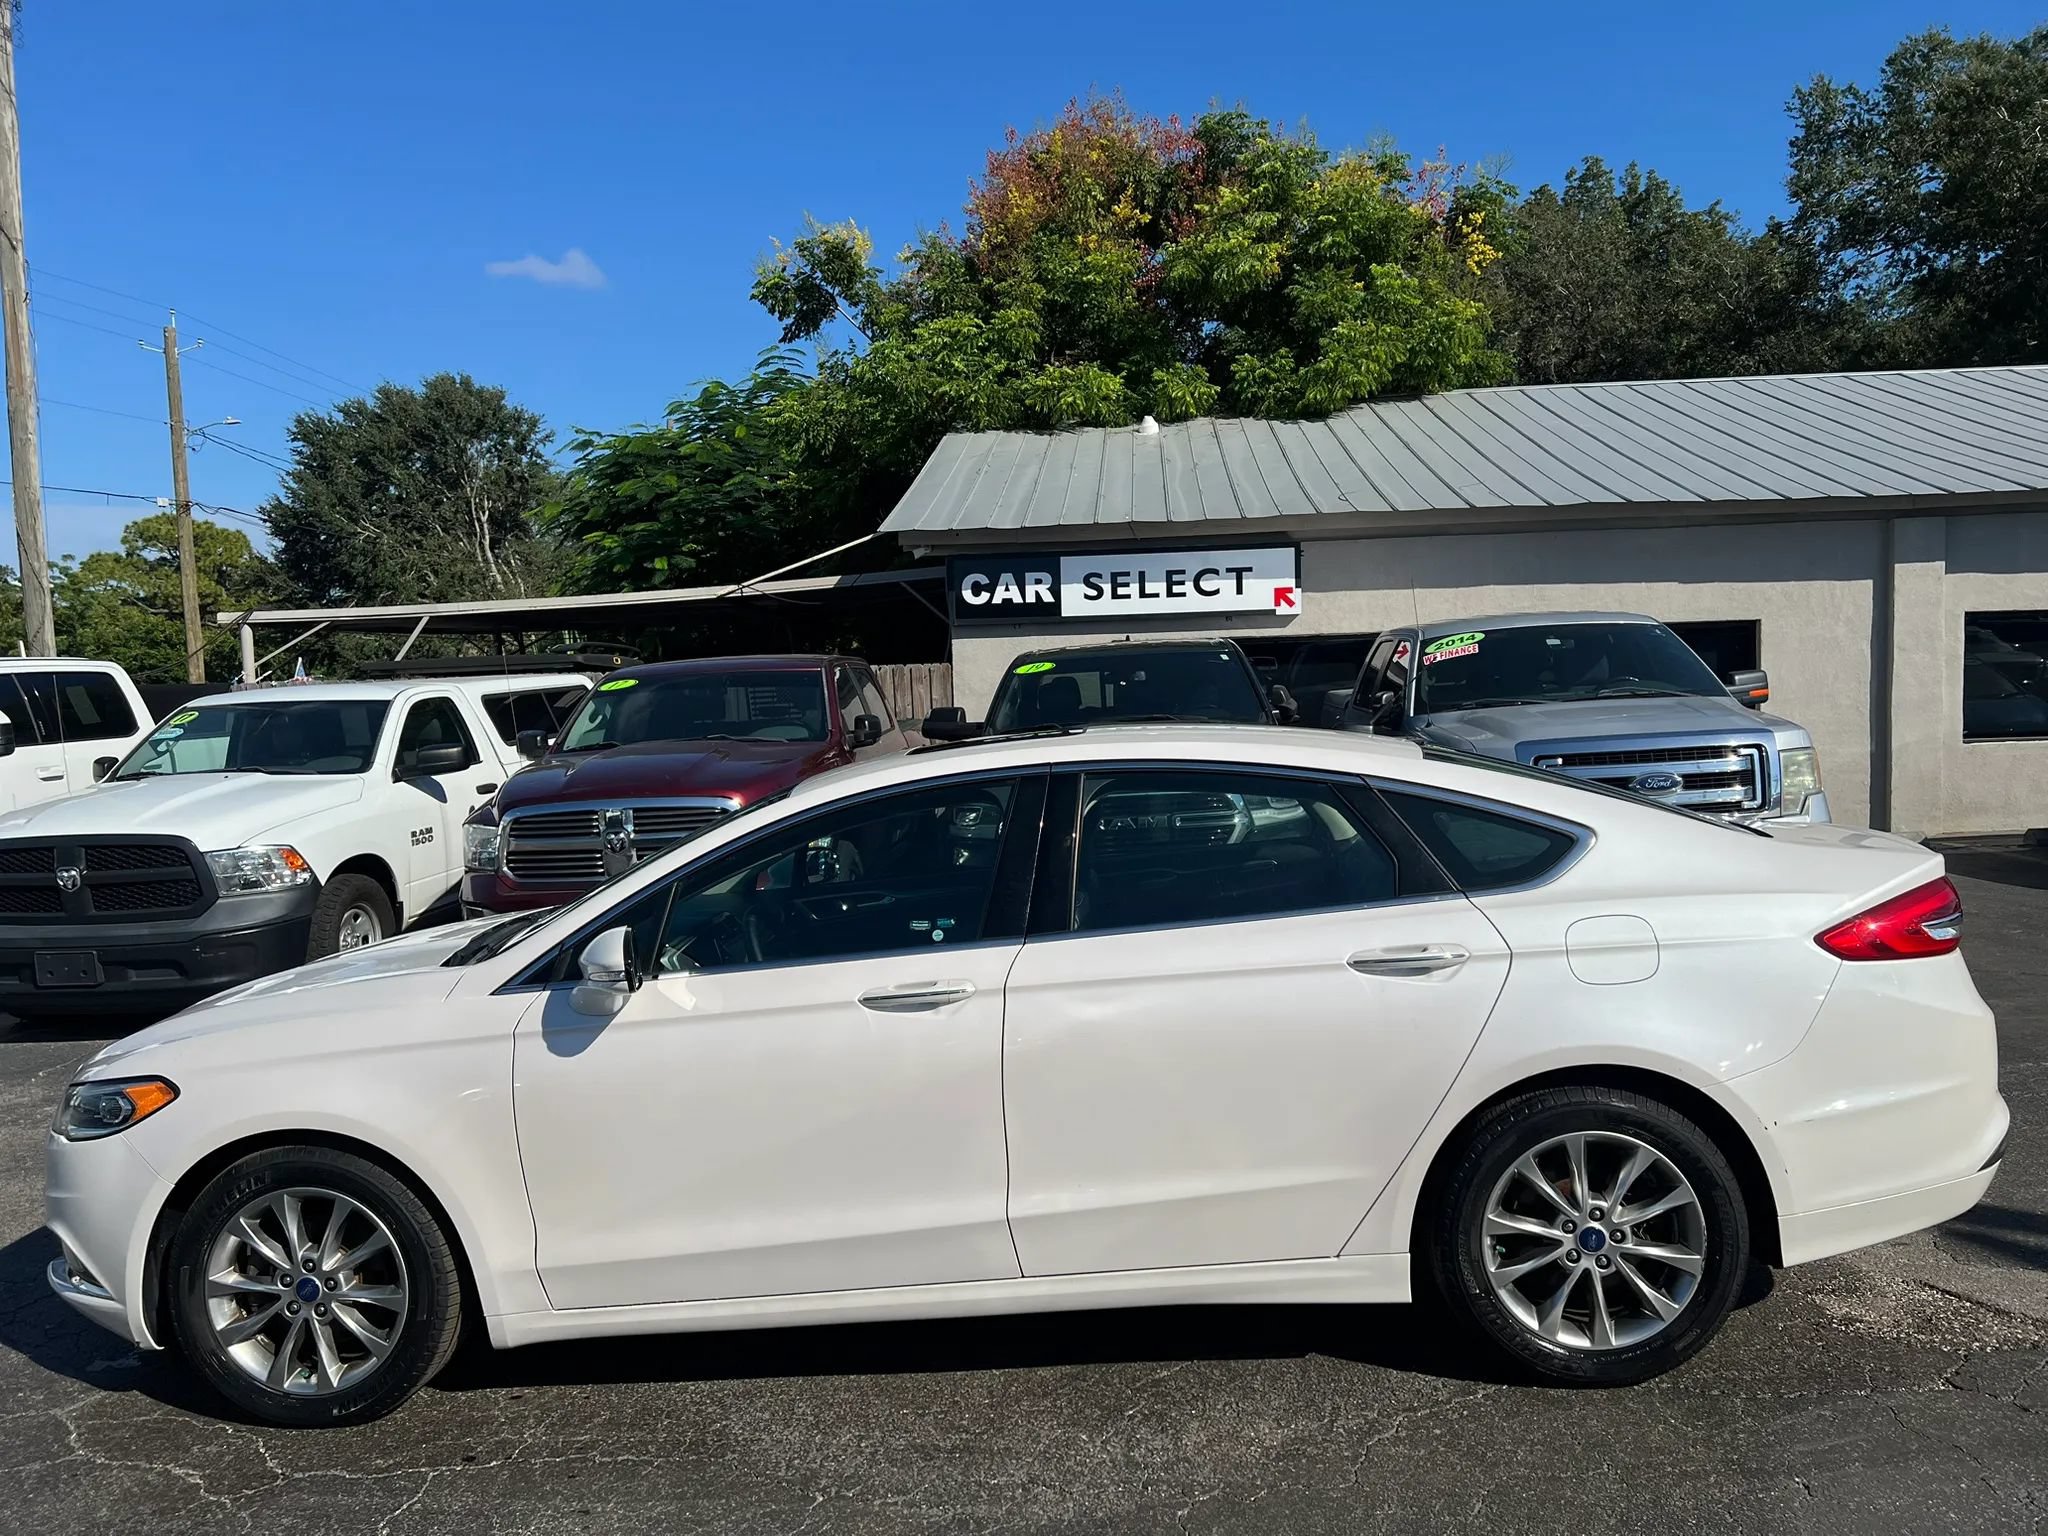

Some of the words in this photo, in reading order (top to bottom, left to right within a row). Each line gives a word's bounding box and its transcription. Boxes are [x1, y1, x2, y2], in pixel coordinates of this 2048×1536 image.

[961, 572, 1055, 605] CAR
[1082, 567, 1254, 601] SELECT
[1433, 633, 1477, 651] 2014
[1440, 645, 1478, 659] FINANCE
[1645, 776, 1672, 788] Ford
[410, 826, 433, 838] RAM
[411, 834, 434, 847] 1500
